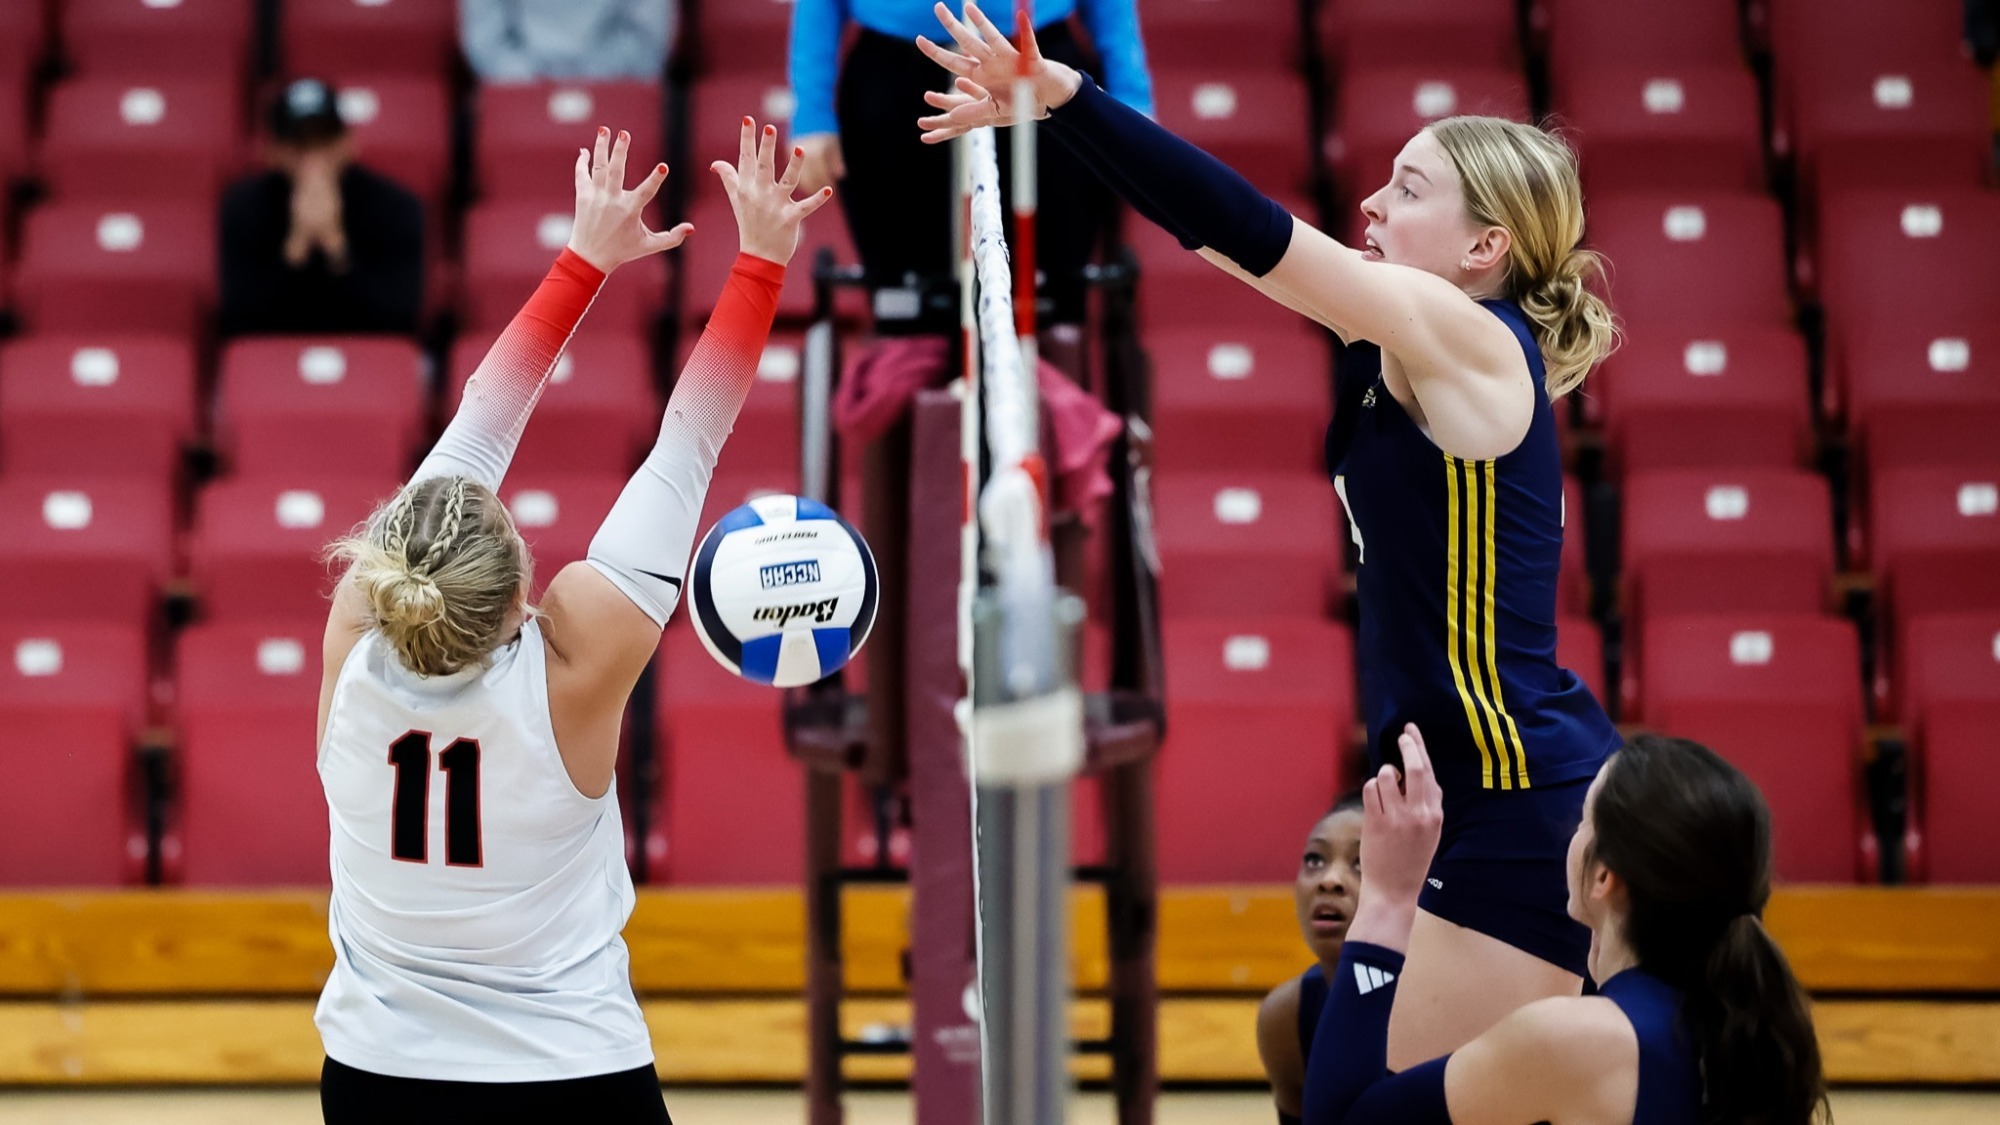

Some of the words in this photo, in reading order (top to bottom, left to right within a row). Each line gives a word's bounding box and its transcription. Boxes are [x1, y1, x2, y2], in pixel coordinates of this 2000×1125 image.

[761, 561, 820, 588] NCCAA
[753, 596, 839, 628] Baden
[388, 729, 483, 868] 11
